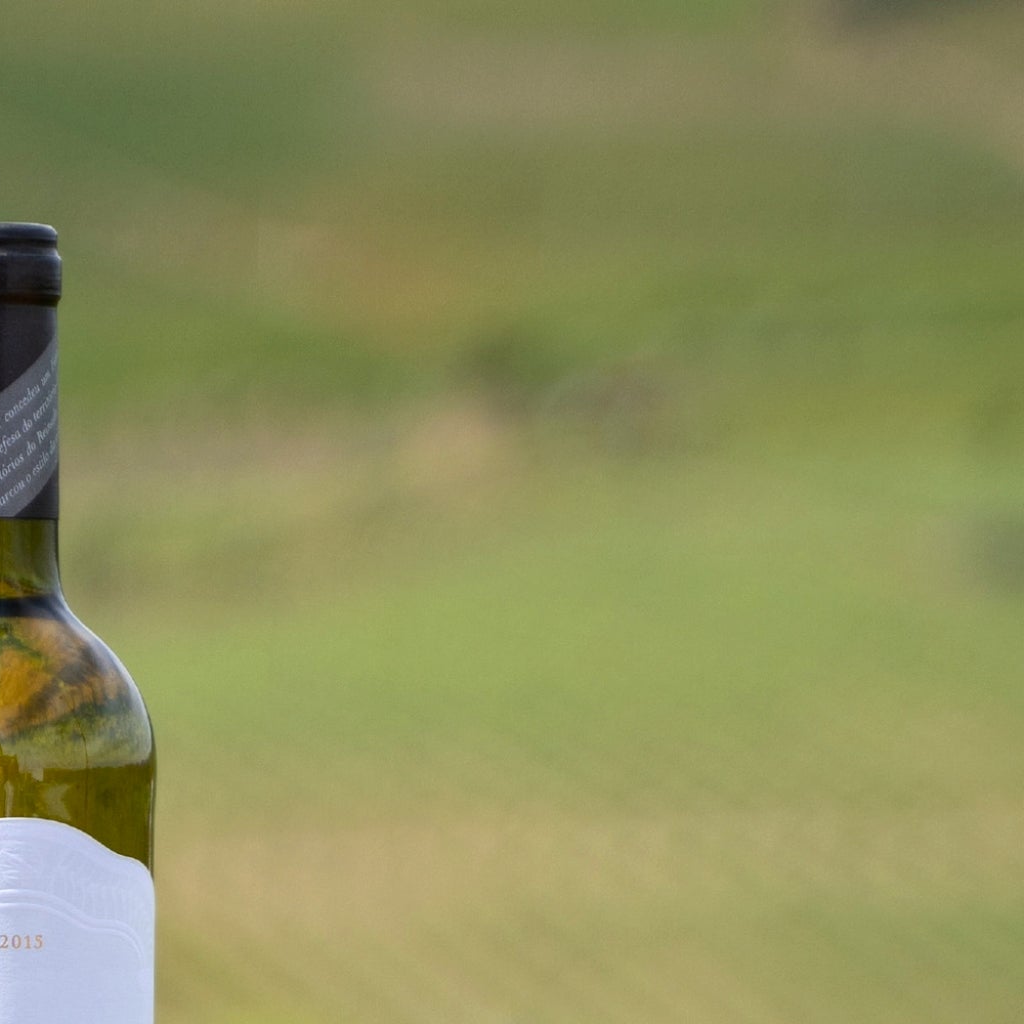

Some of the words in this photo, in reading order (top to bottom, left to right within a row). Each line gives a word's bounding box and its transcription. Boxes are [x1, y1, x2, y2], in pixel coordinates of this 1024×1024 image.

[4, 385, 41, 422] concedeu
[22, 418, 33, 433] do
[26, 441, 37, 456] do
[0, 934, 44, 950] 2015
